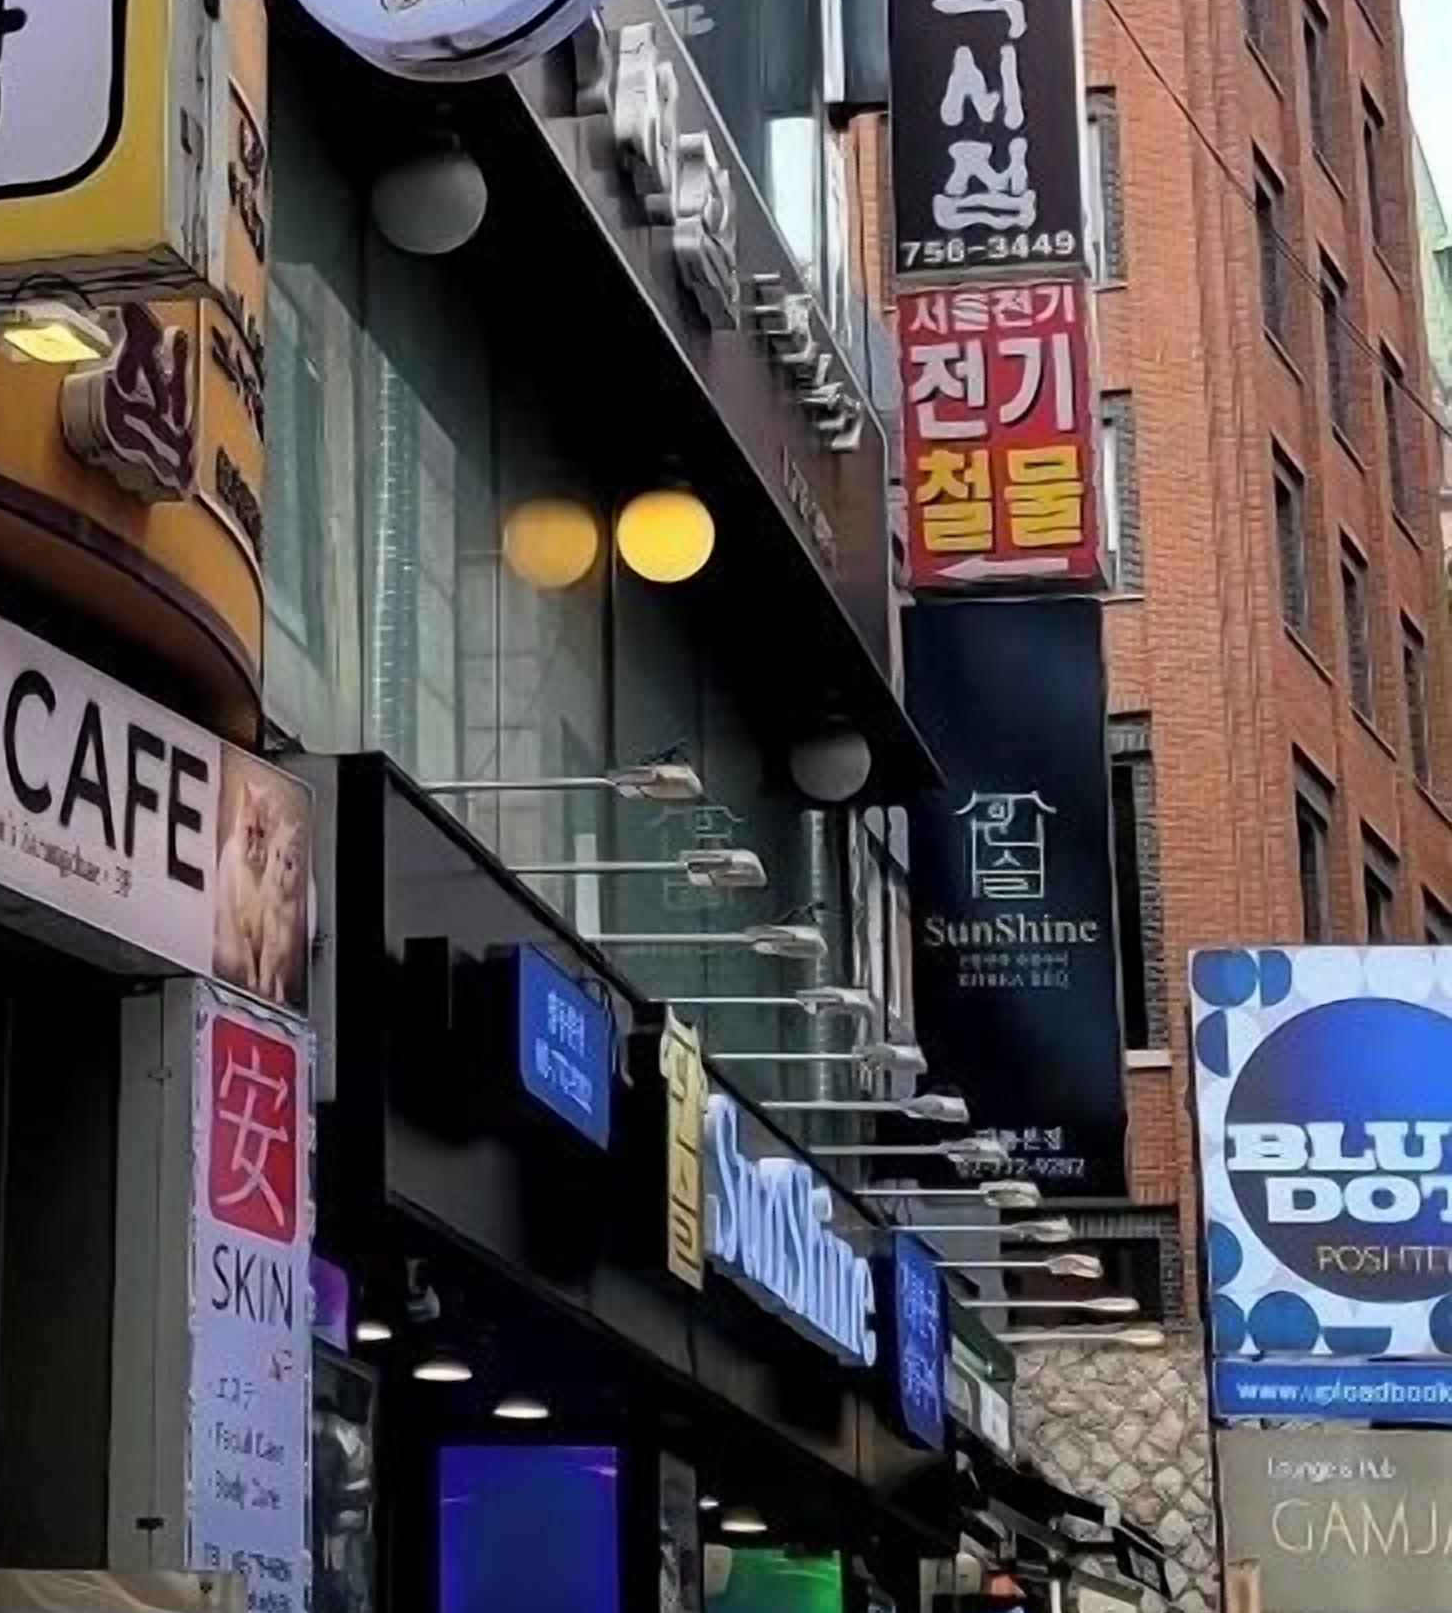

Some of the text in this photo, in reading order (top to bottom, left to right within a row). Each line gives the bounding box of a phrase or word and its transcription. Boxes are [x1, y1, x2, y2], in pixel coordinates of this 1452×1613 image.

[909, 331, 1077, 440] 전기
[915, 441, 1086, 555] 철물
[3, 670, 209, 892] CAFE
[924, 912, 1098, 947] SunShine
[215, 1043, 289, 1226] 安
[211, 1244, 294, 1330] SKIN
[1316, 1245, 1452, 1272] POSHTE
[1272, 1498, 1452, 1555] GAMJ
